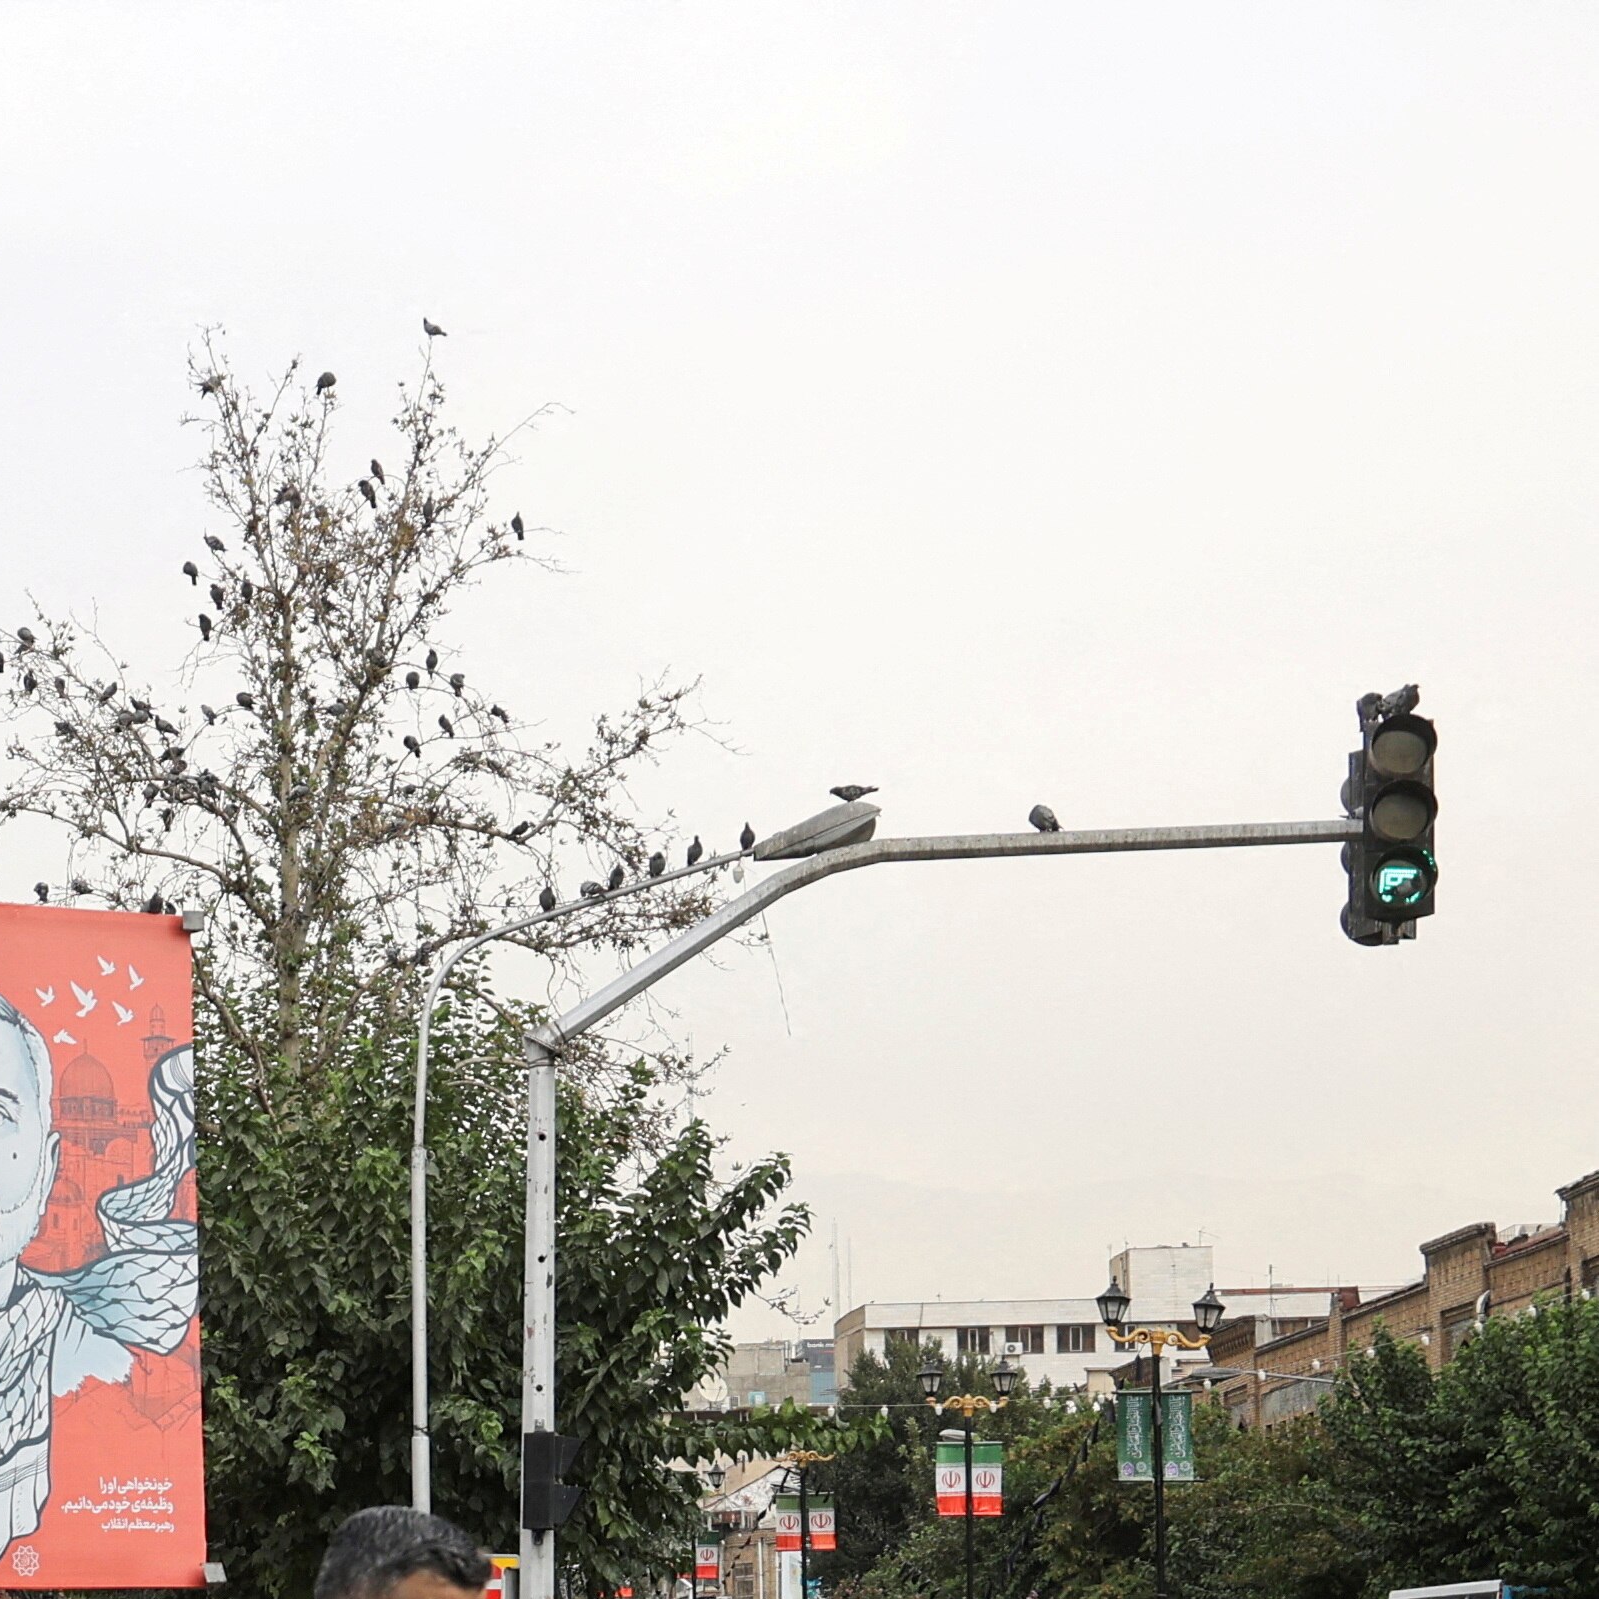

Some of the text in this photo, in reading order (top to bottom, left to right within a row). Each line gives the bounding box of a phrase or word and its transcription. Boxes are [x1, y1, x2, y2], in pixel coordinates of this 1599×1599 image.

[117, 1476, 173, 1495] خونخواهی
[108, 1496, 131, 1513] خود
[101, 1517, 175, 1533] رهبر معظم انقلاب
